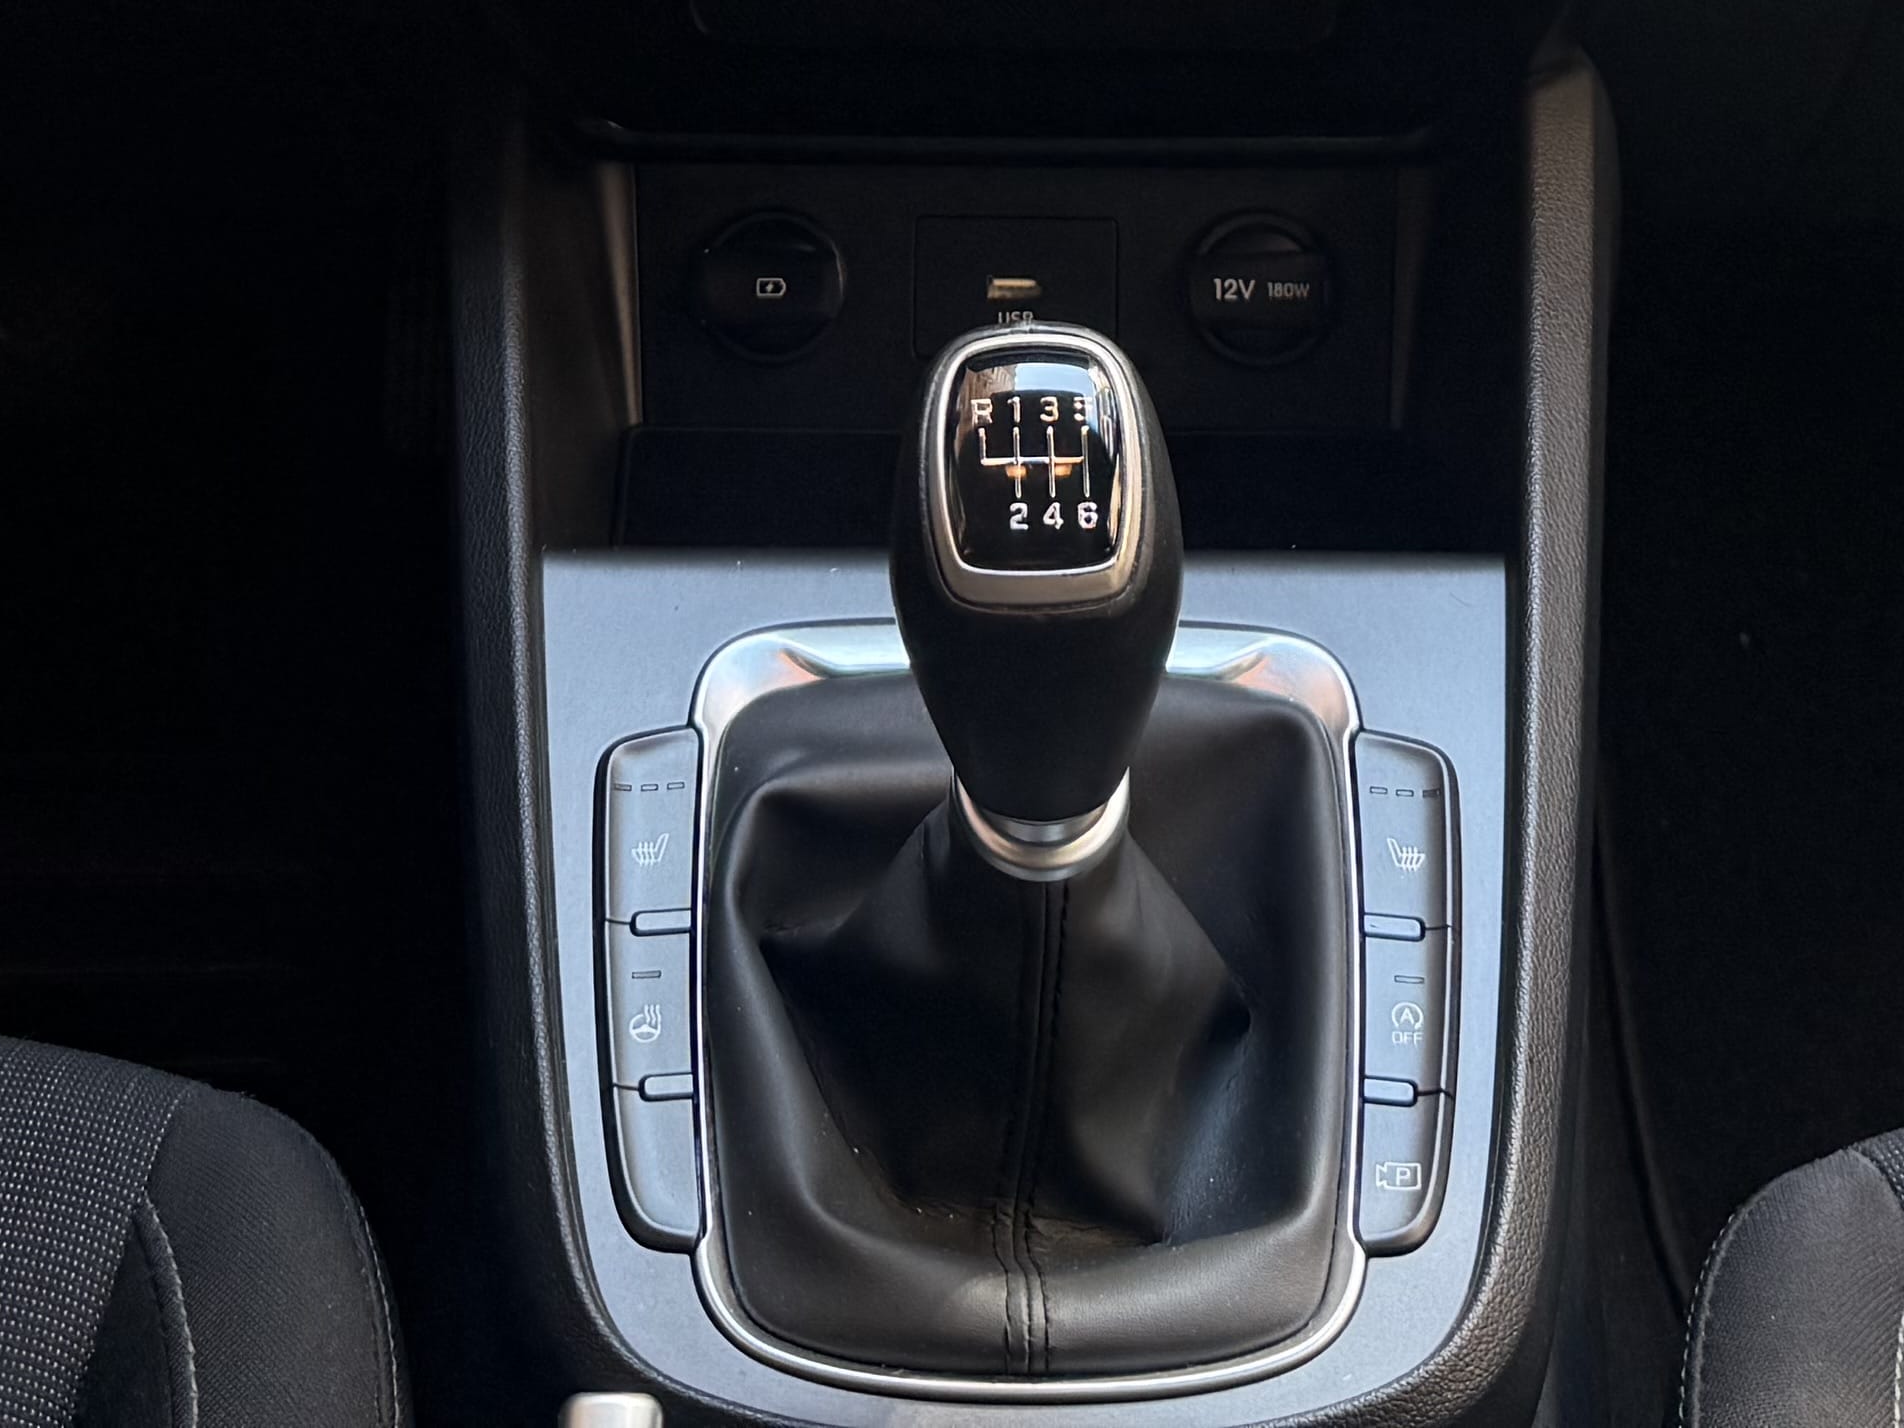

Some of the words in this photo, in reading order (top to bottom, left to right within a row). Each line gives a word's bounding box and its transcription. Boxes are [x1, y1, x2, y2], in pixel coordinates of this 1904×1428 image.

[1213, 278, 1256, 300] 12V
[1267, 281, 1310, 298] 180W
[971, 397, 993, 424] R
[1007, 396, 1021, 424] 1
[1039, 396, 1059, 421] 3
[1073, 397, 1093, 421] 5
[1009, 502, 1029, 530] 2
[1042, 502, 1064, 530] 4
[1077, 502, 1098, 530] 6
[1391, 1031, 1424, 1047] OFF
